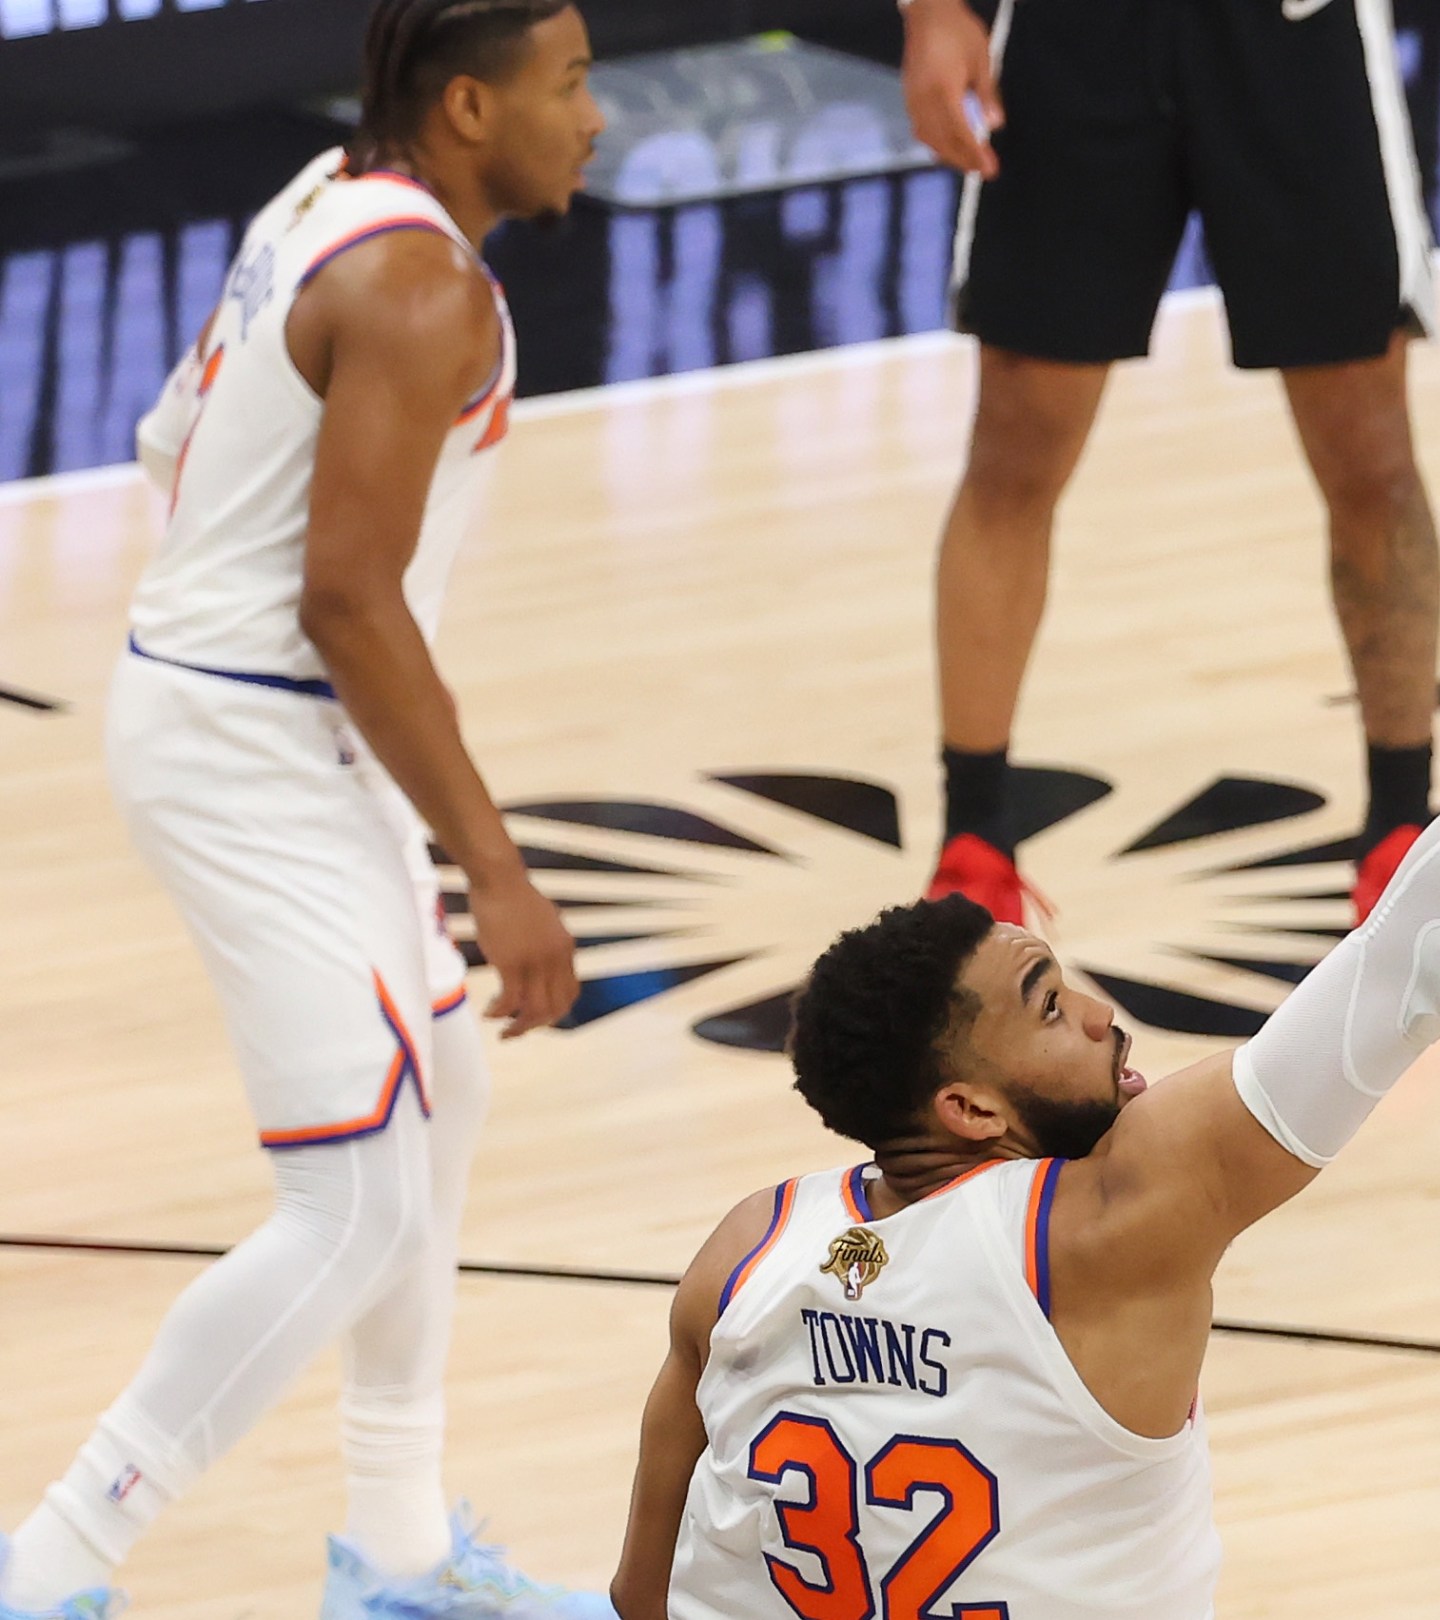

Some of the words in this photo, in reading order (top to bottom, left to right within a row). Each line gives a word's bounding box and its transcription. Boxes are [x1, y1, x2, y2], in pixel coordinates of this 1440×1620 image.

[820, 1239, 883, 1270] Finals
[801, 1308, 951, 1398] TOWNS
[747, 1410, 1010, 1620] 32
